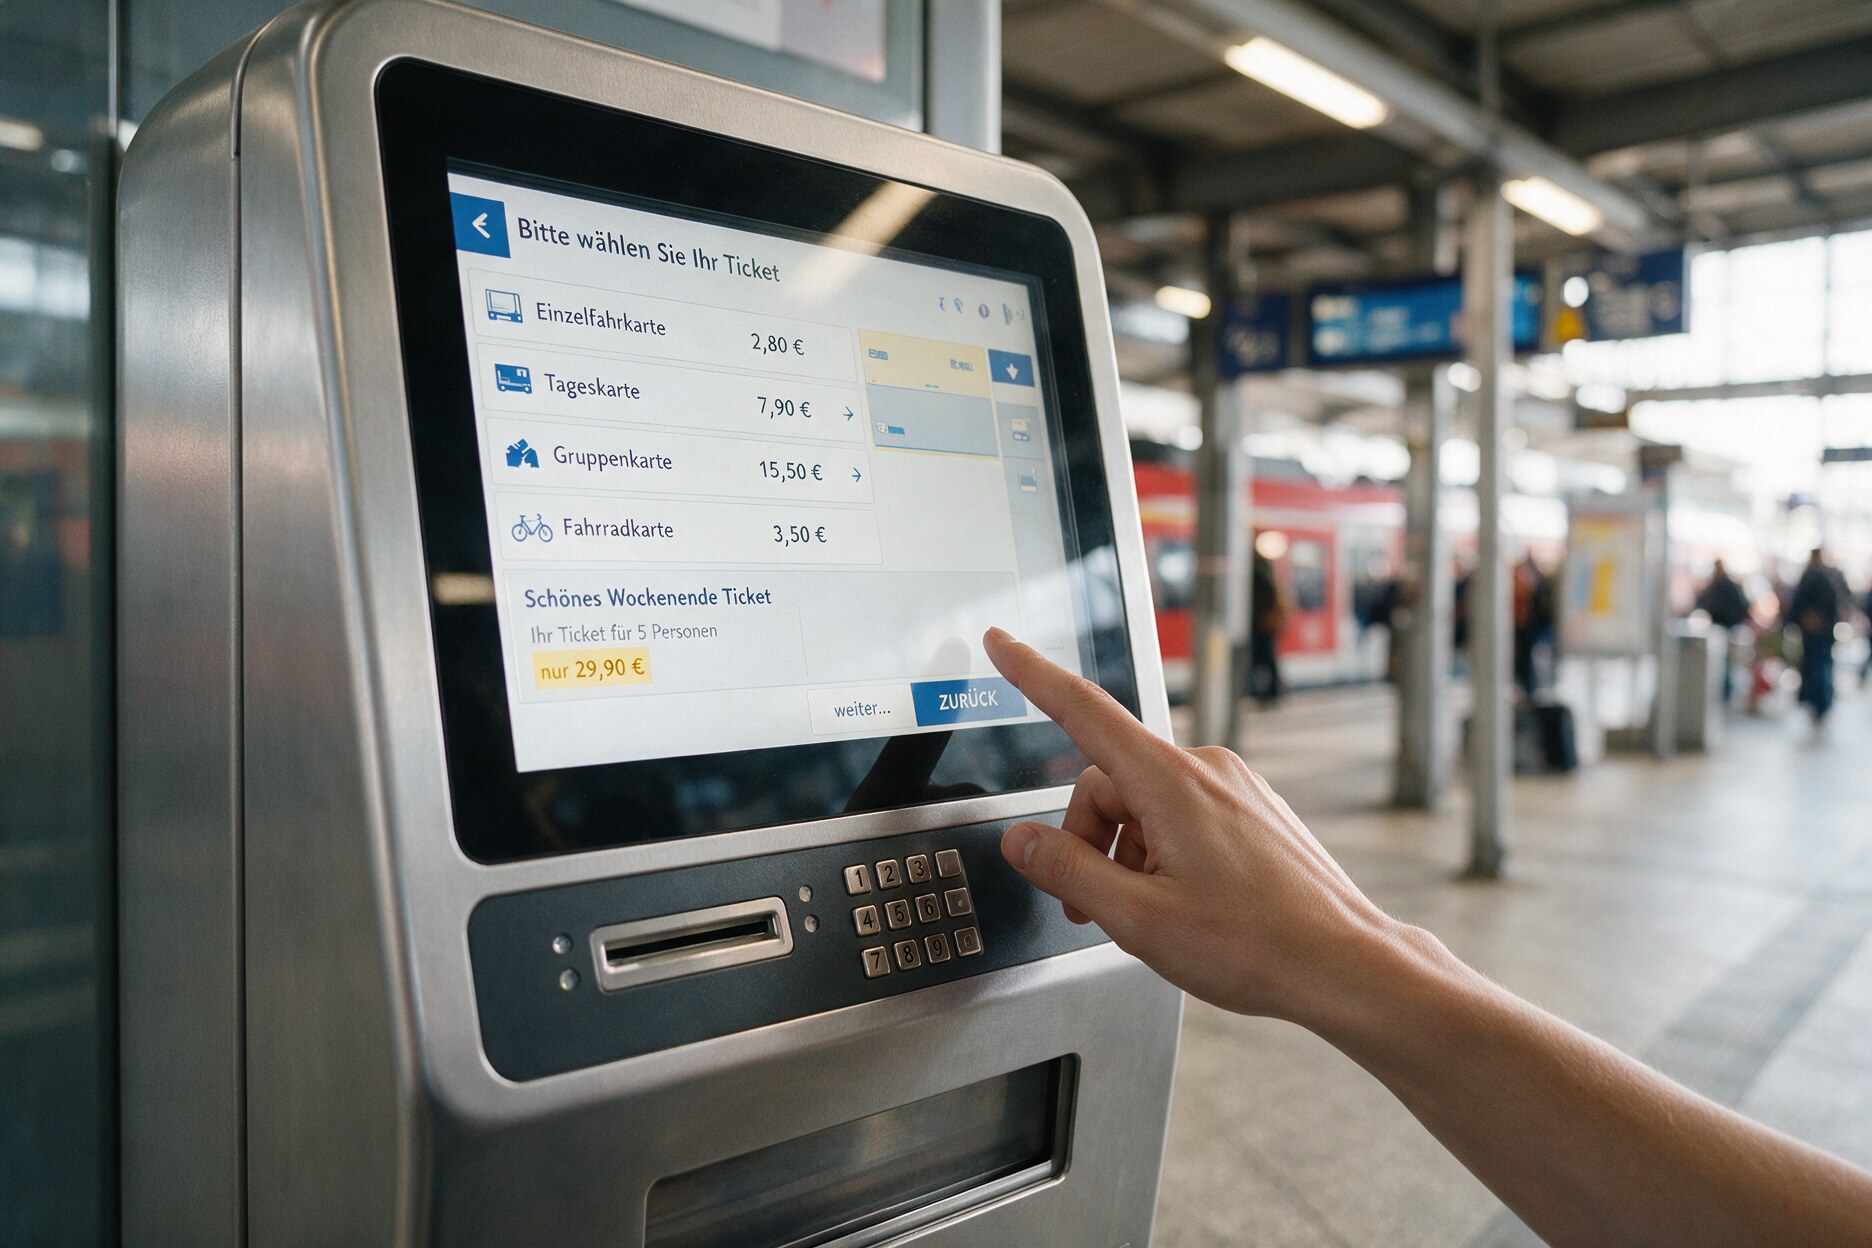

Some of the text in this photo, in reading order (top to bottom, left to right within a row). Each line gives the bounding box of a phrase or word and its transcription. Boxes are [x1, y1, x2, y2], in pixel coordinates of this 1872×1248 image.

[517, 217, 780, 282] Bitte wählen Sie Ihr Ticket
[536, 302, 666, 336] Einzelfahrkarte
[751, 333, 805, 356] 2,80 €
[544, 373, 640, 401] Tageskarte
[757, 396, 812, 419] 7,90 €
[553, 446, 673, 472] Gruppenkarte
[759, 461, 823, 483] 15,50 €
[563, 518, 674, 539] Fahrradkarte
[773, 525, 827, 547] 3,50 €
[524, 586, 772, 608] Schönes Wockenende Ticket
[531, 623, 718, 644] Ihr Ticket für 5 Personen
[541, 657, 645, 682] nur 29,90 €
[834, 701, 891, 718] weiter...
[939, 688, 998, 711] ZURÜCK
[855, 860, 925, 887] 1 2 3
[863, 899, 934, 929] 4 5 6
[870, 952, 880, 970] 7
[903, 945, 914, 963] 8
[933, 939, 942, 957] 9
